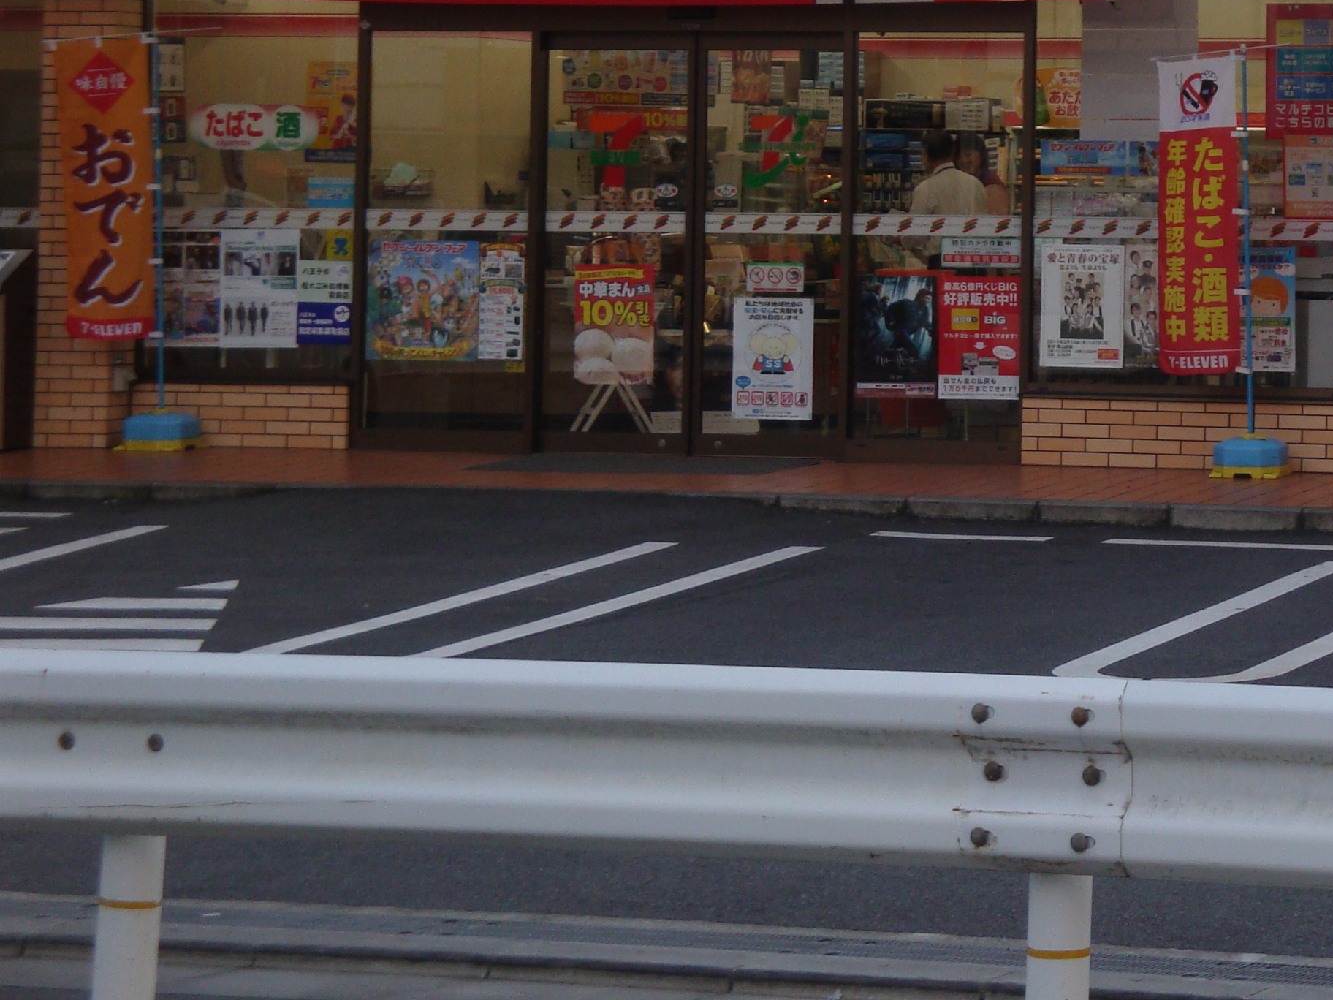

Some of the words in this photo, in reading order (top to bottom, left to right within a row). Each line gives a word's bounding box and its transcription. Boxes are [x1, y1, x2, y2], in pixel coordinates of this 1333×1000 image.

[204, 109, 264, 137] たばこ
[275, 111, 302, 138] 酒
[72, 123, 144, 308] おでん
[1163, 138, 1188, 343] 年齢確認実施中
[1192, 135, 1231, 342] たばこ・酒類
[579, 280, 635, 299] 中華まん
[943, 292, 1018, 307] 好評販売中!!
[983, 315, 1007, 325] BIG
